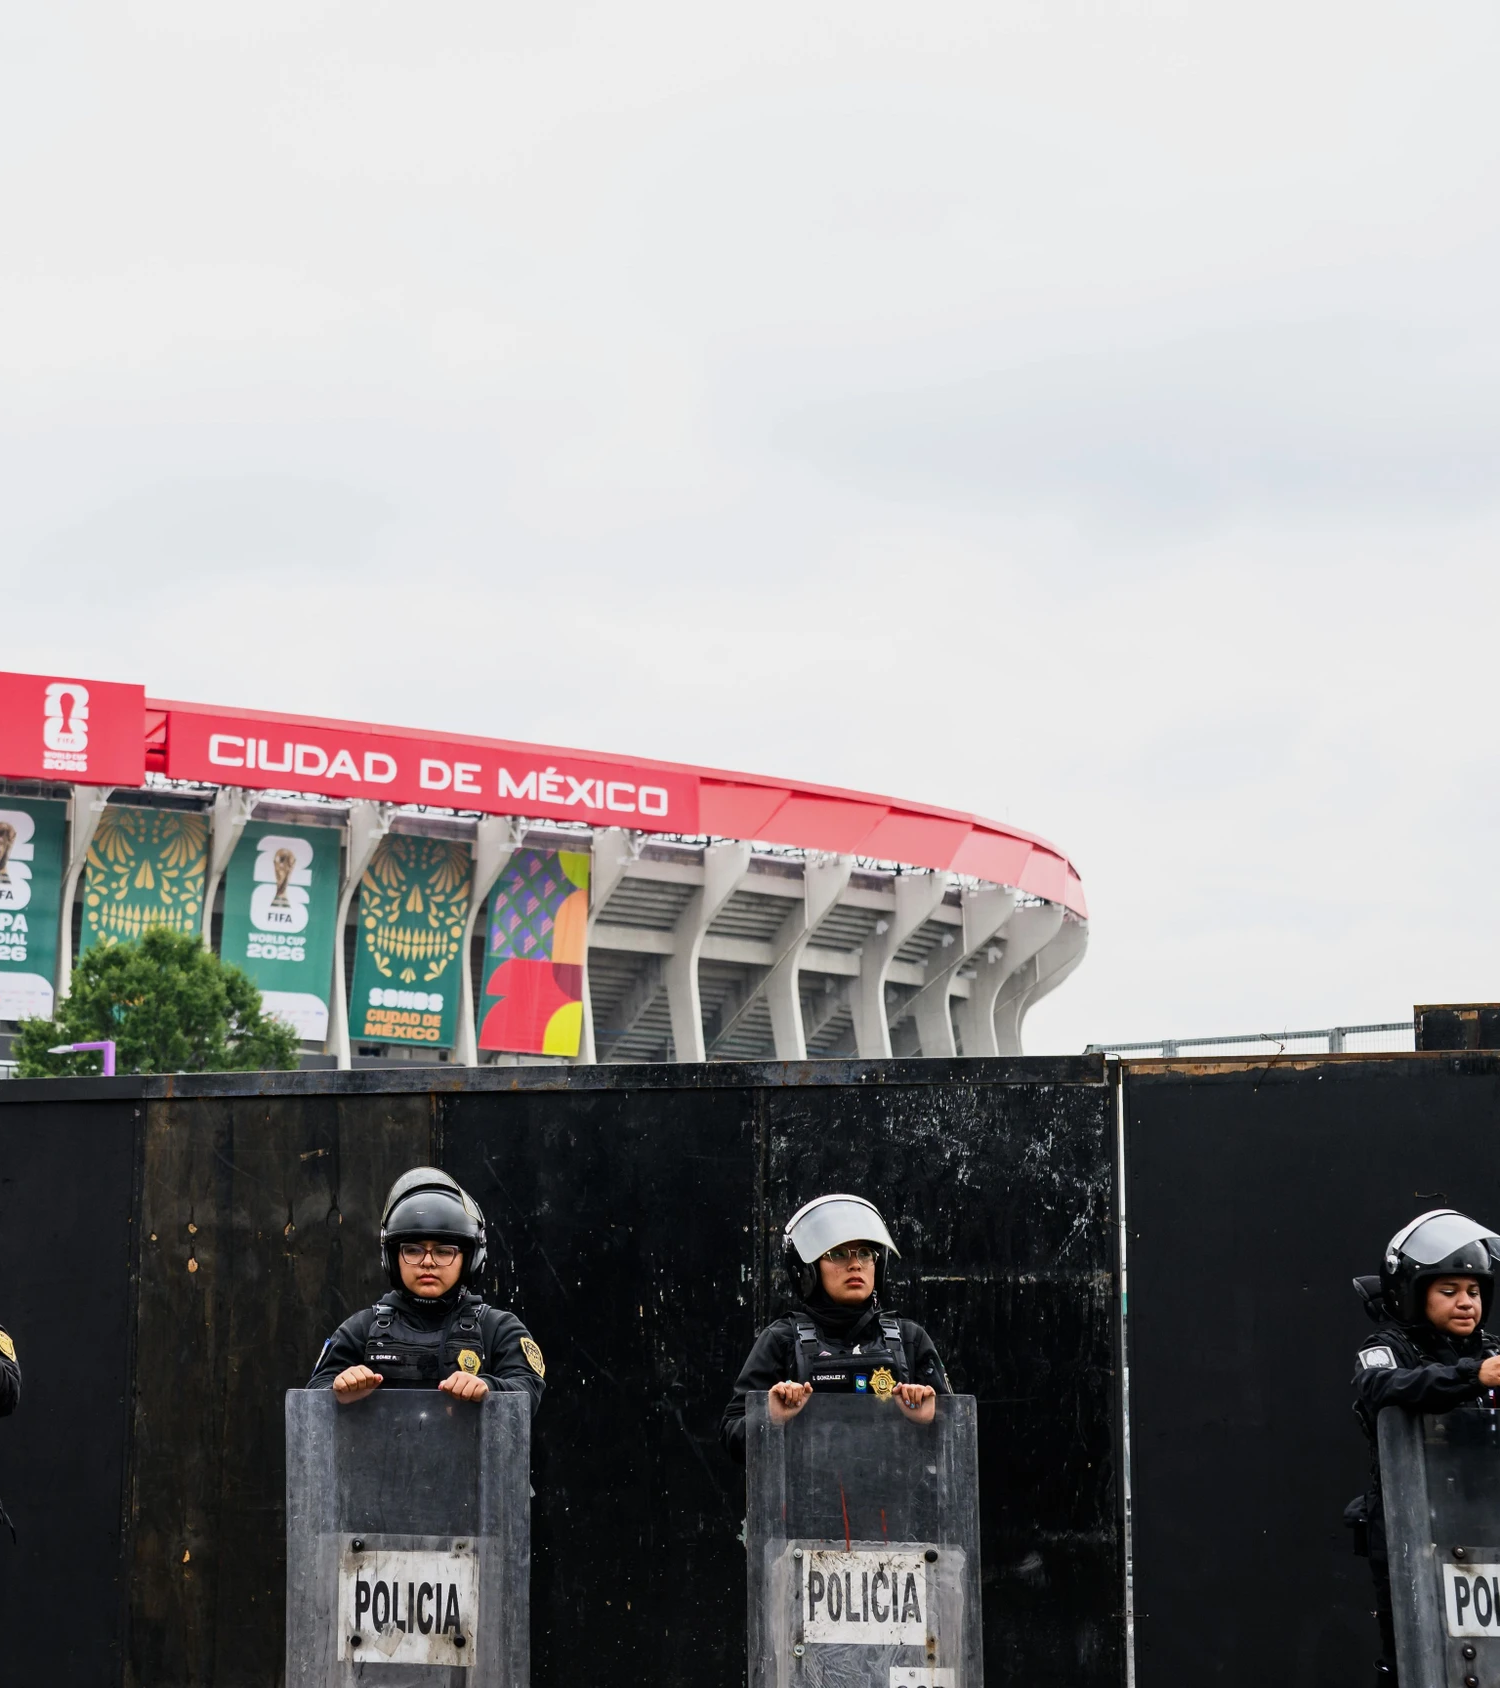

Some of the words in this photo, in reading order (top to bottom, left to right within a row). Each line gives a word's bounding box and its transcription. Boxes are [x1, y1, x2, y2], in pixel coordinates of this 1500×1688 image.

[43, 758, 88, 772] 2026
[208, 733, 398, 784] CIUDAD
[419, 758, 482, 794] DE
[498, 766, 668, 817] MÉXICO
[267, 912, 293, 923] FIFA
[248, 933, 286, 945] WORLD
[286, 936, 306, 946] CUP
[246, 943, 306, 962] 2026
[366, 1009, 421, 1025] CIUDAD
[422, 1013, 442, 1028] DE
[809, 1570, 922, 1623] POLICIA
[355, 1580, 462, 1635] POLICIA
